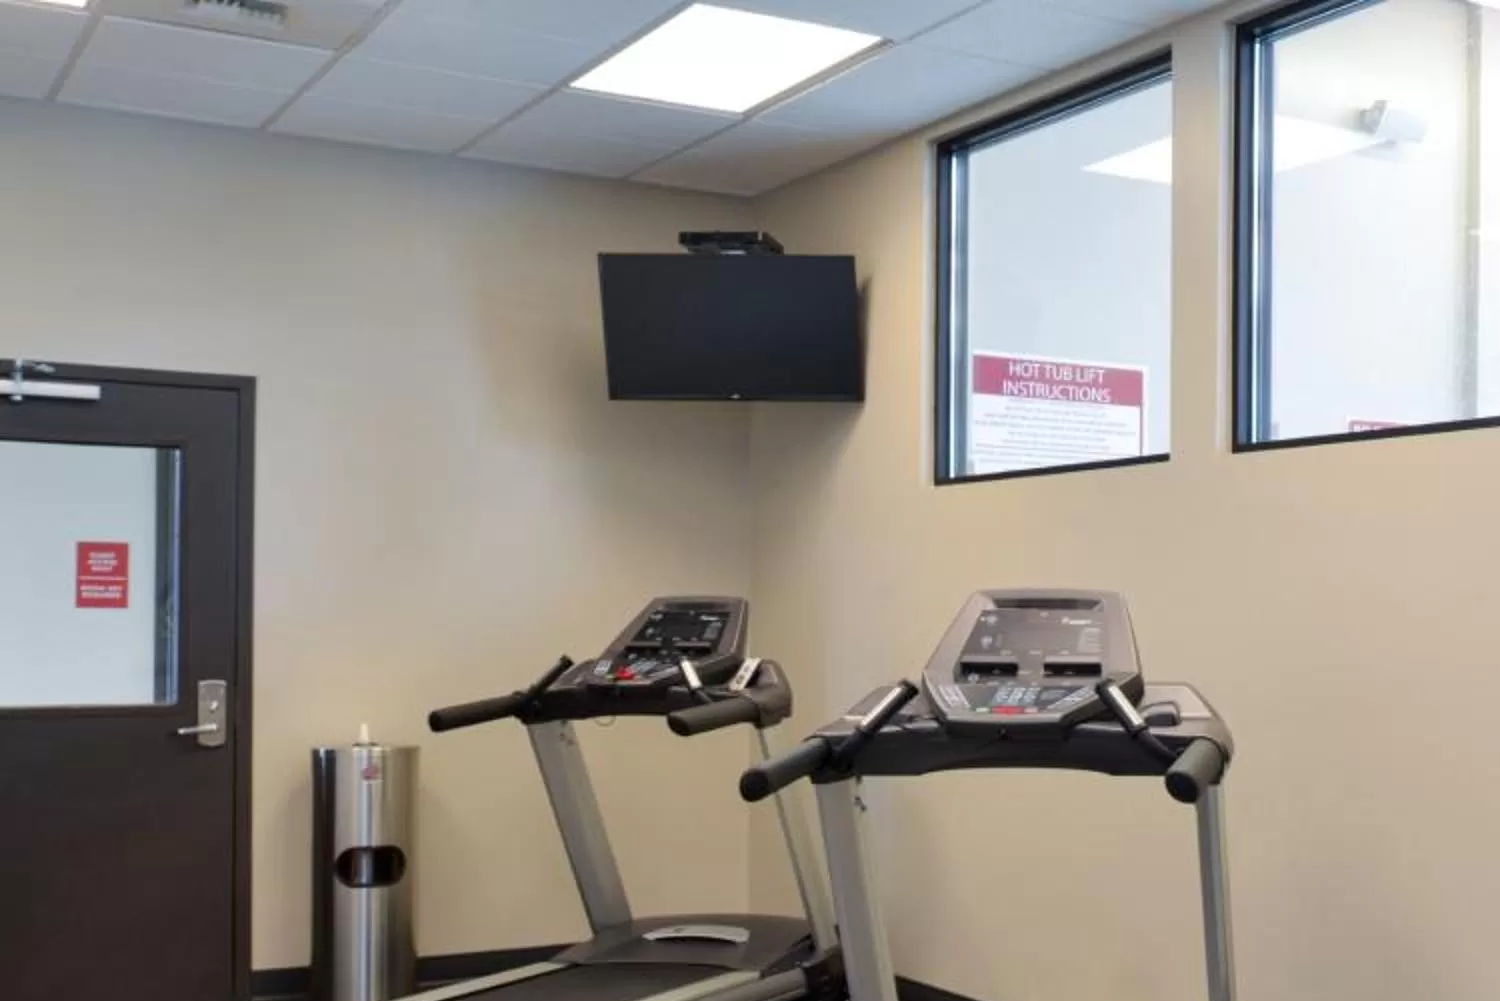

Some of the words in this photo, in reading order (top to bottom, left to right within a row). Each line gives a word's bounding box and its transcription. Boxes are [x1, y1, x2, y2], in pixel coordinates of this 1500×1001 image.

[1008, 360, 1040, 378] HOT
[1044, 364, 1073, 381] TUB
[1075, 367, 1105, 385] LIFT
[1003, 380, 1112, 403] INSTRUCTIONS
